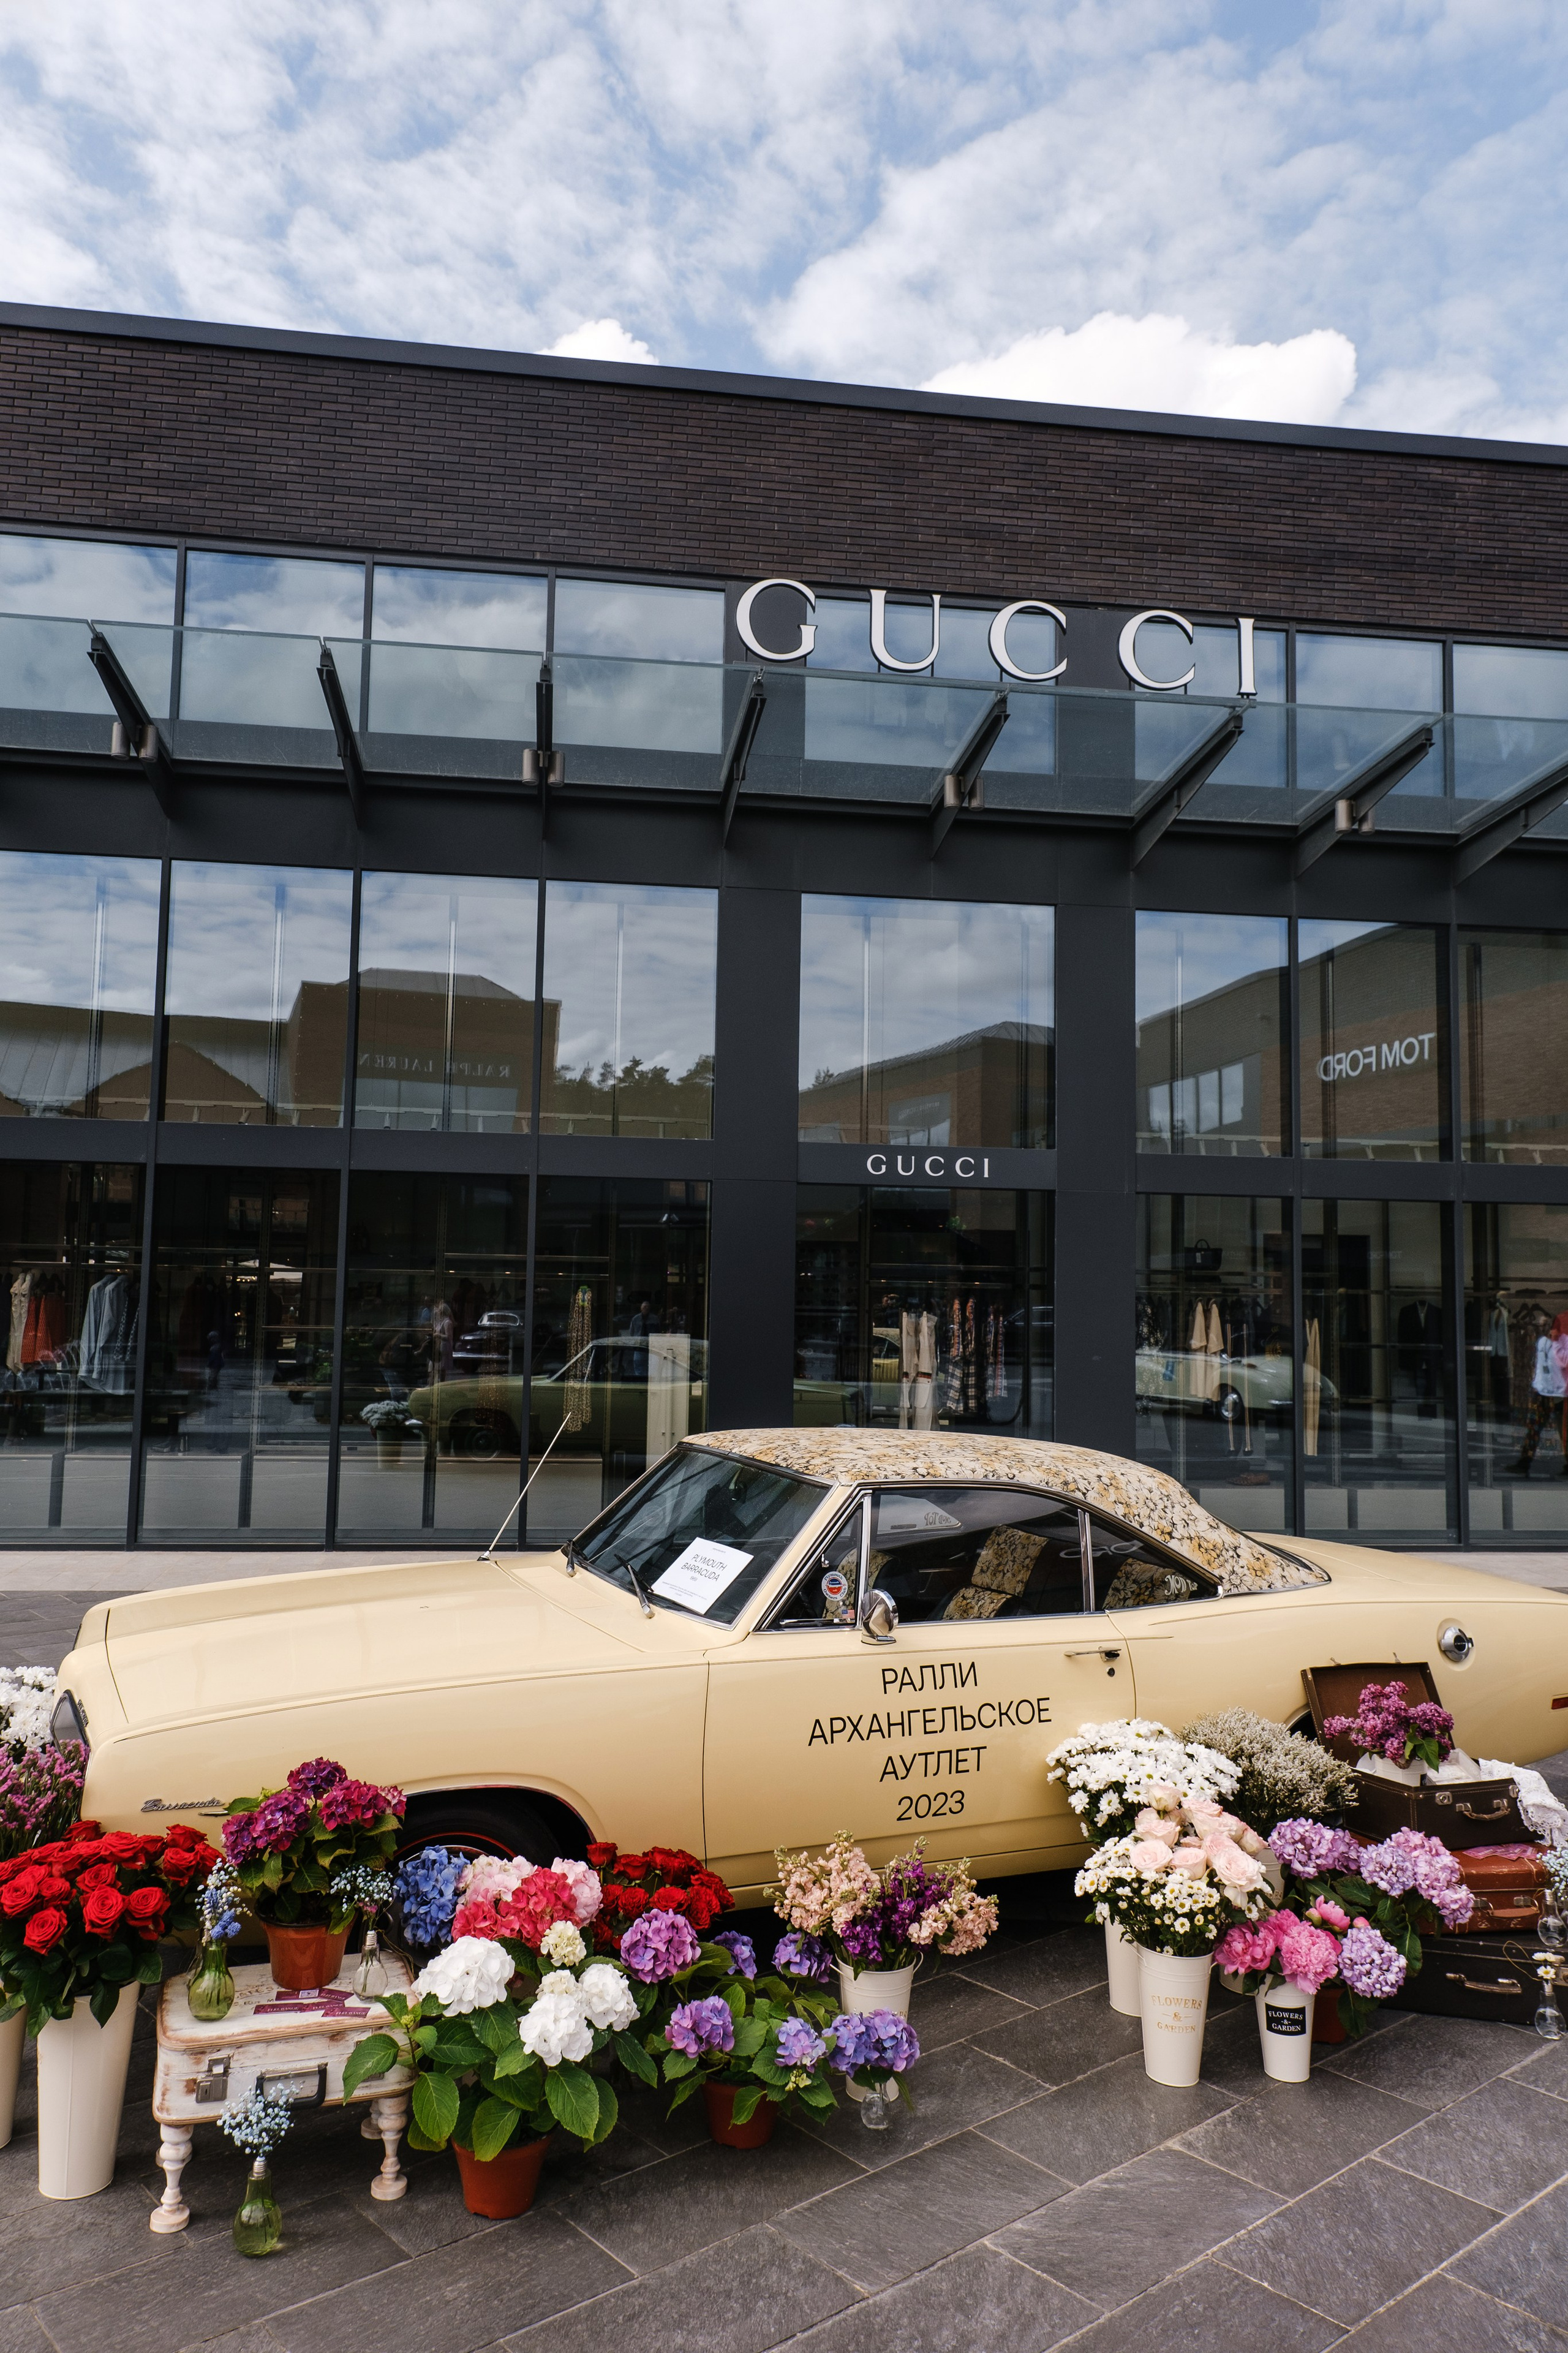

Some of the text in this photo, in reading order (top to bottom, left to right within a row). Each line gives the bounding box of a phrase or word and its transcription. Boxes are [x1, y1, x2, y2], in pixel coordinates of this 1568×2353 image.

[736, 578, 1258, 697] GUCCI
[866, 1154, 989, 1178] GUCCI
[681, 1562, 720, 1582] BARRACUDA
[691, 1554, 728, 1571] PLYMOUTH
[881, 1661, 978, 1694] РАЛЛИ
[807, 1697, 1052, 1747] АРХАНГЕЛЬСКОЕ
[879, 1745, 987, 1783] АУТЛЕТ
[140, 1797, 225, 1813] Barracuda
[896, 1790, 965, 1821] 2023
[1151, 1995, 1202, 2010] FLOWERS
[1268, 2011, 1303, 2020] FLOWERS
[1157, 2021, 1196, 2034] GARDEN
[1272, 2023, 1301, 2031] GARDEN
